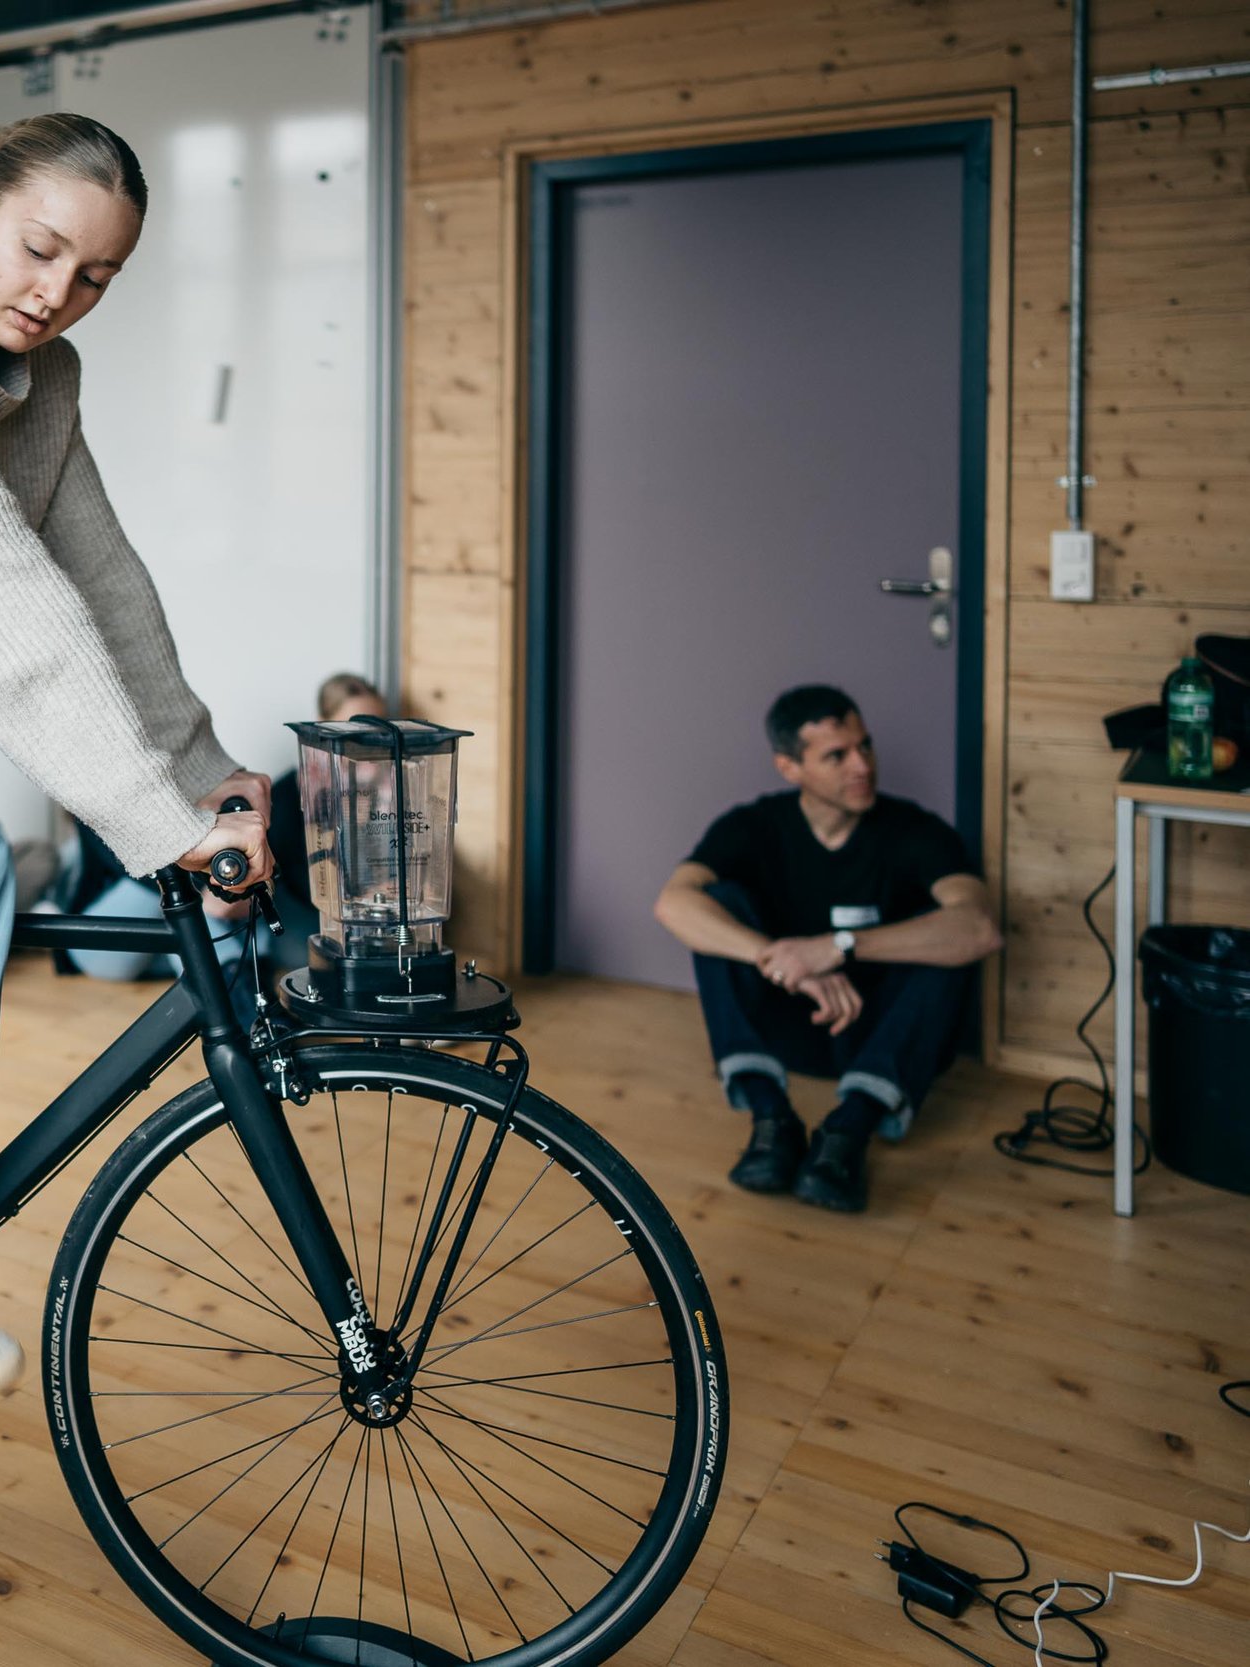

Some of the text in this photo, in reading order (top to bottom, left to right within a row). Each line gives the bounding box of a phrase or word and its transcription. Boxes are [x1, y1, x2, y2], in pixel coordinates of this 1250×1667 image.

[370, 810, 424, 821] blentec
[50, 1292, 66, 1432] CONTINENTAL
[336, 1319, 369, 1374] MBUS
[350, 1315, 377, 1368] COLU
